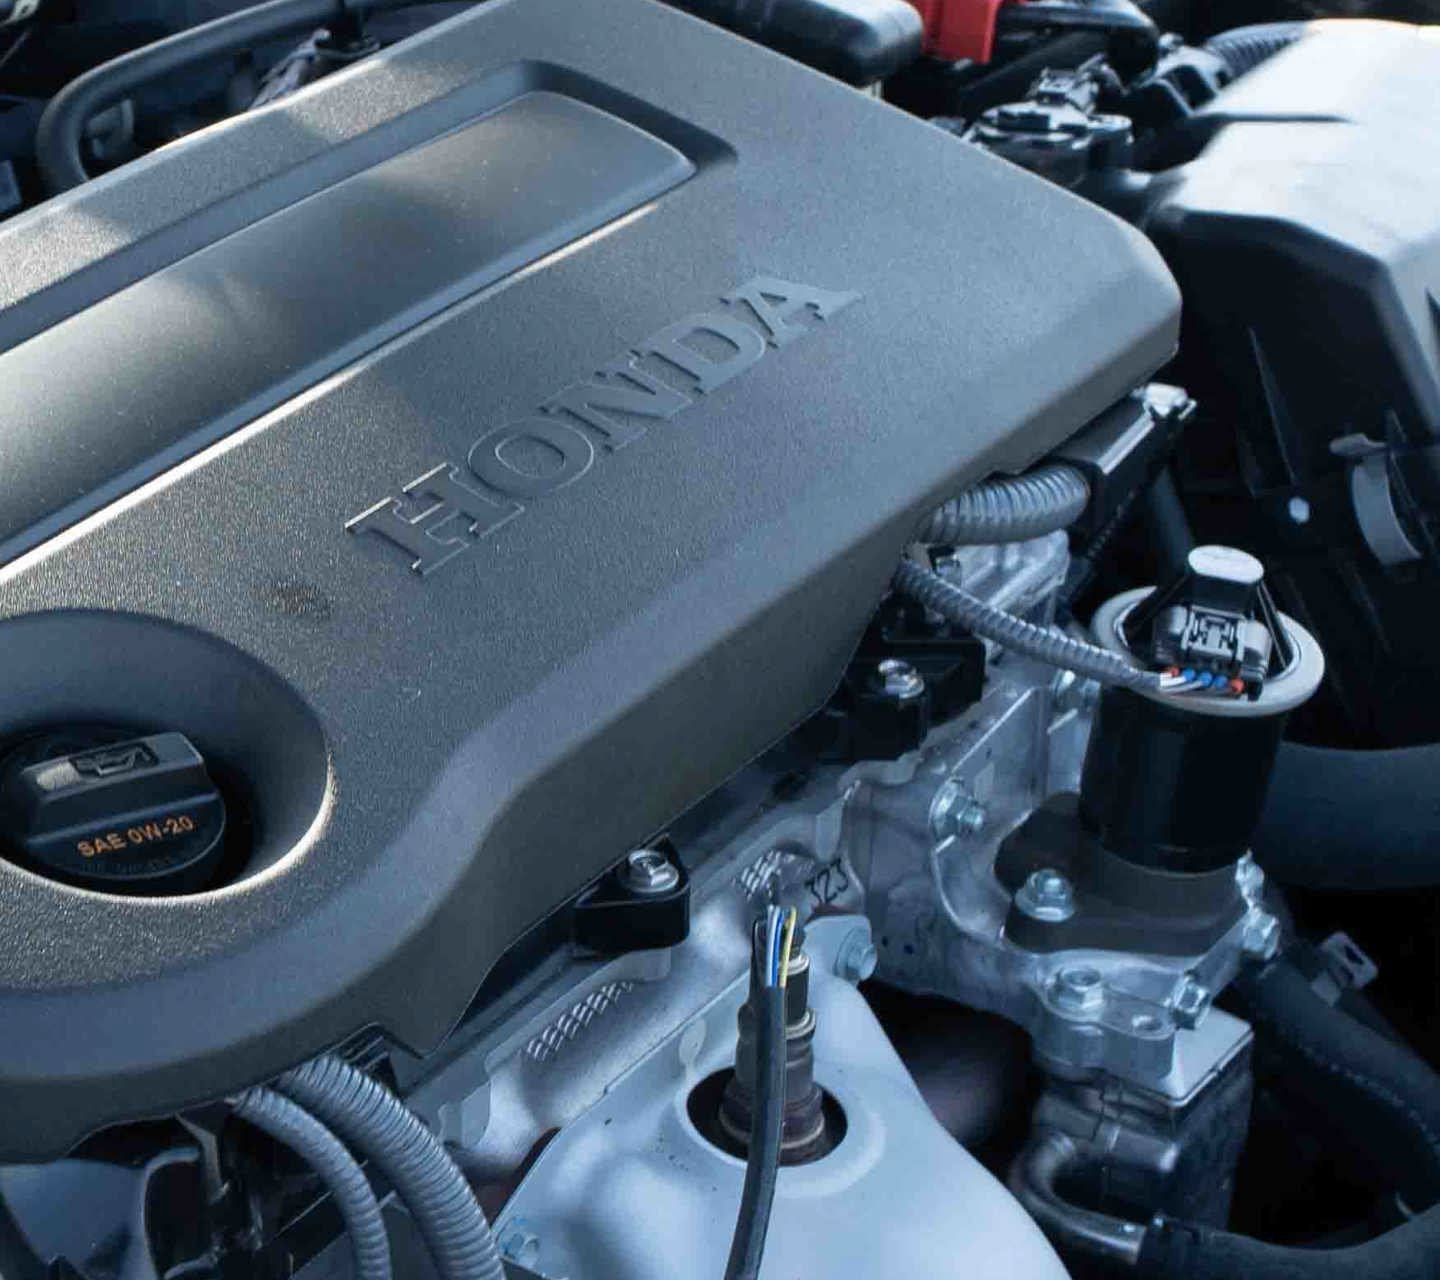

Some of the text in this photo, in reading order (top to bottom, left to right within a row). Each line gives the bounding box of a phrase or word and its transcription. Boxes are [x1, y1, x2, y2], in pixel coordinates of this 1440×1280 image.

[343, 274, 864, 577] HONDA
[76, 832, 125, 860] SAE
[126, 816, 195, 850] 0W-20
